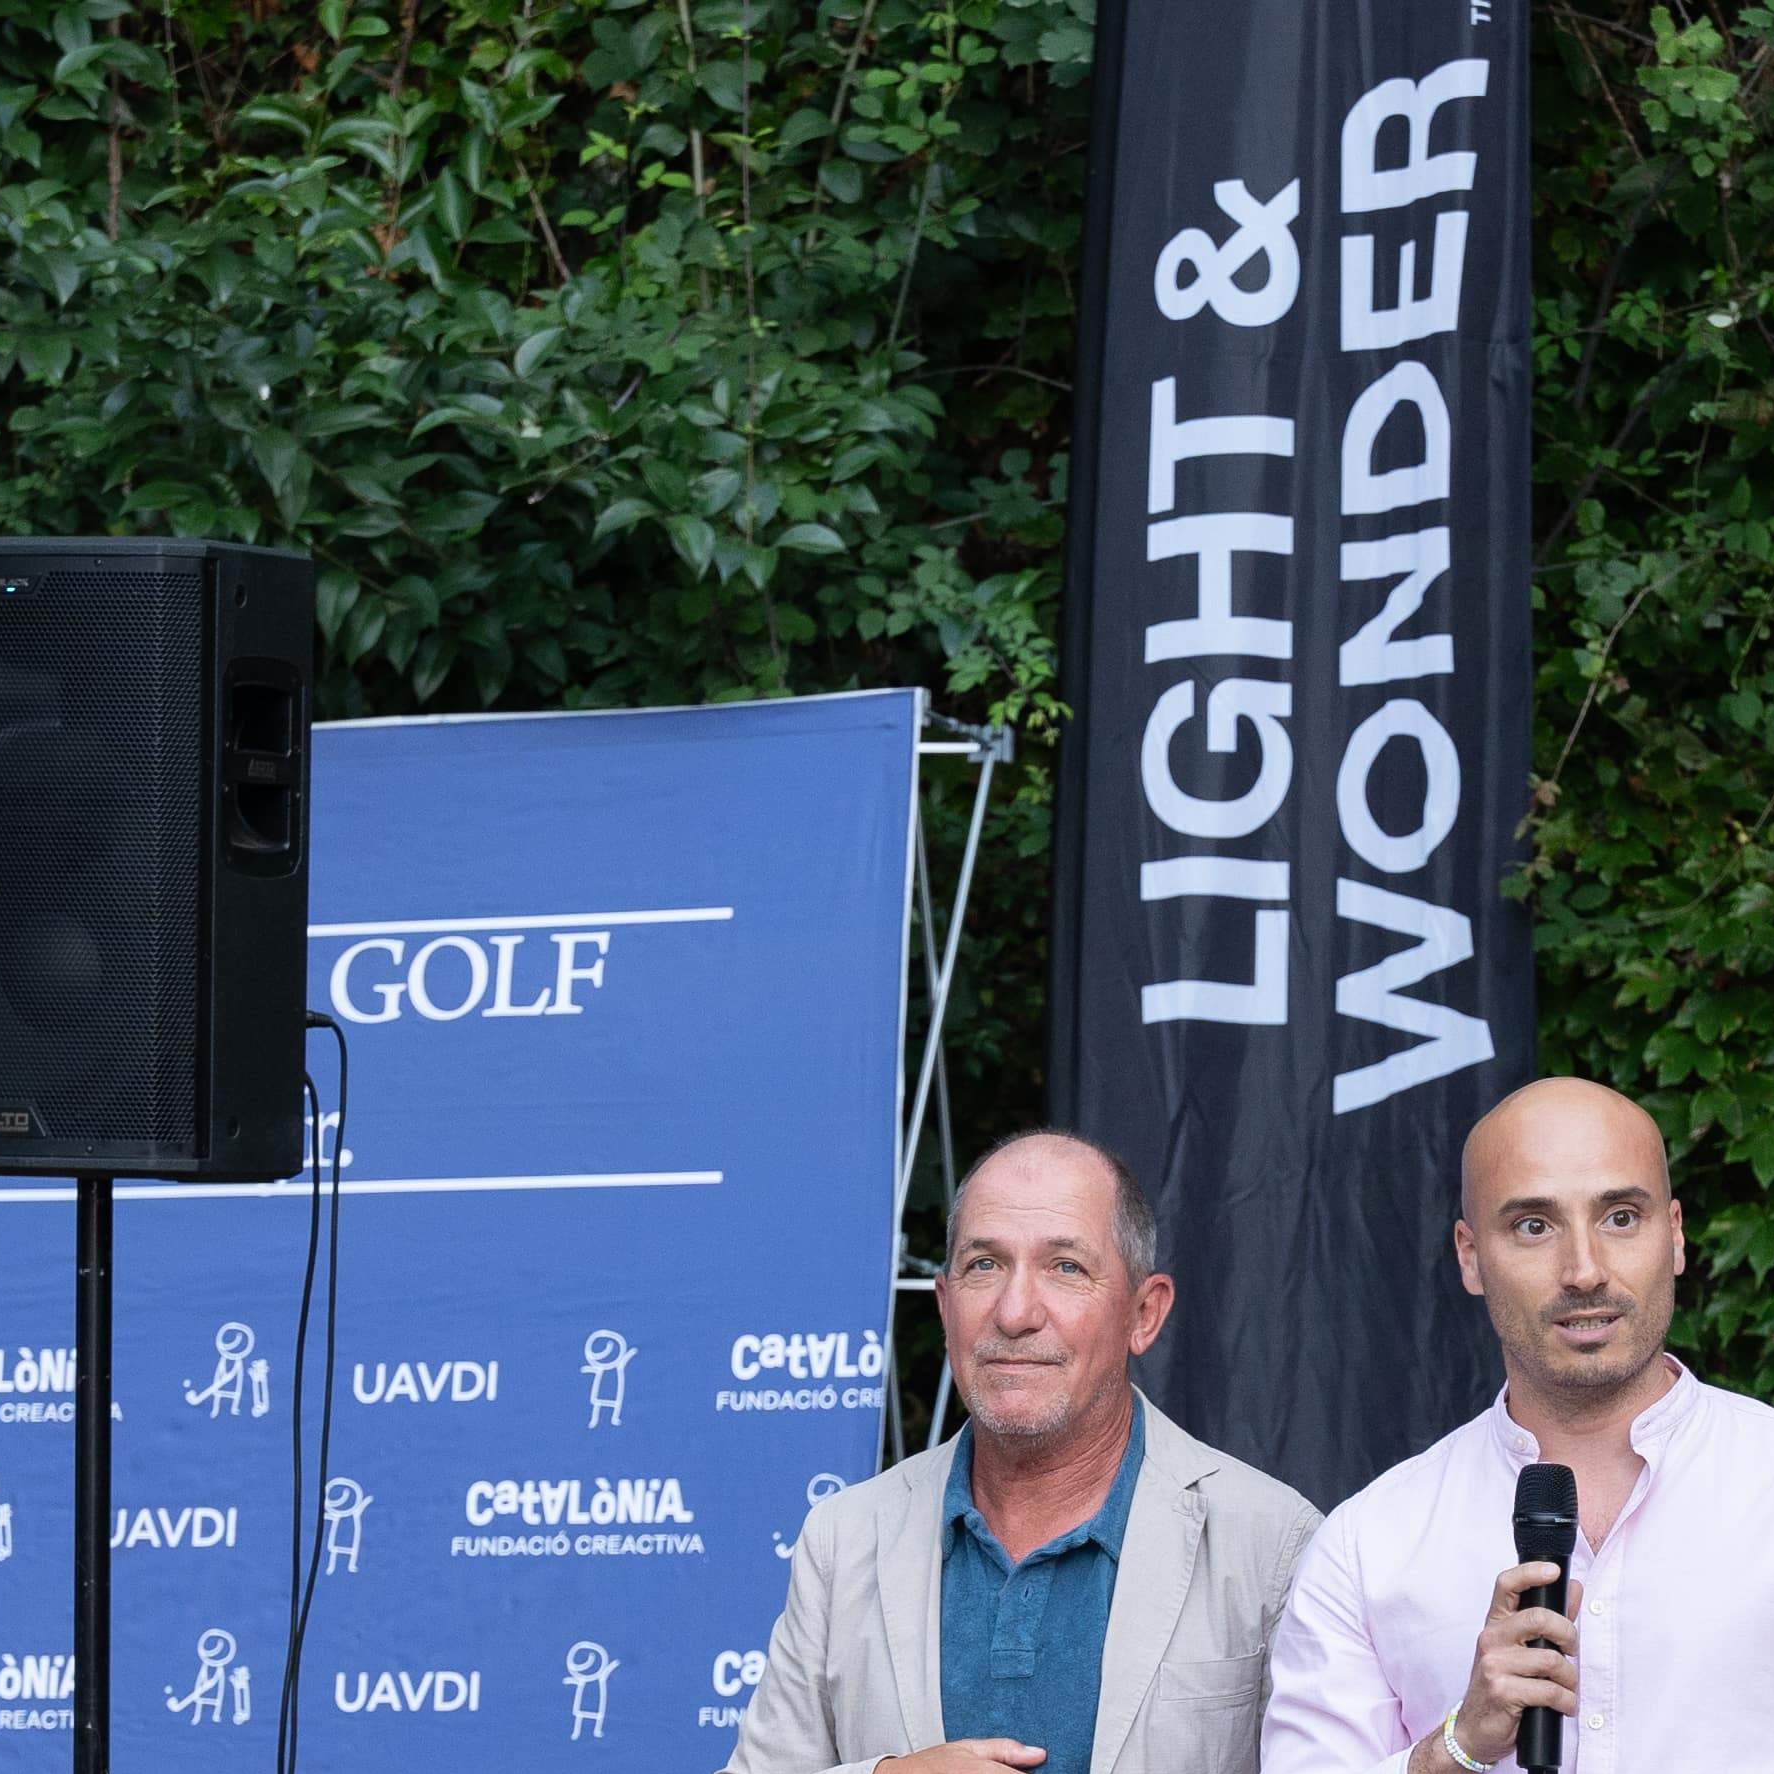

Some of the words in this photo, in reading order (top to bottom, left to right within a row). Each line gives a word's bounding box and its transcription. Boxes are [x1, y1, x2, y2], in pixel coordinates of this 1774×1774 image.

[1154, 178, 1301, 327] &
[1332, 58, 1496, 1115] WONDER
[1140, 377, 1295, 1026] LIGHT
[329, 931, 611, 1024] GOLF
[353, 1360, 498, 1404] UAVDI
[716, 1388, 835, 1412] FUNDACIÓ
[451, 1531, 569, 1557] FUNDACIÓ
[574, 1532, 704, 1556] CREACTIVA
[334, 1670, 480, 1713] UAVDI
